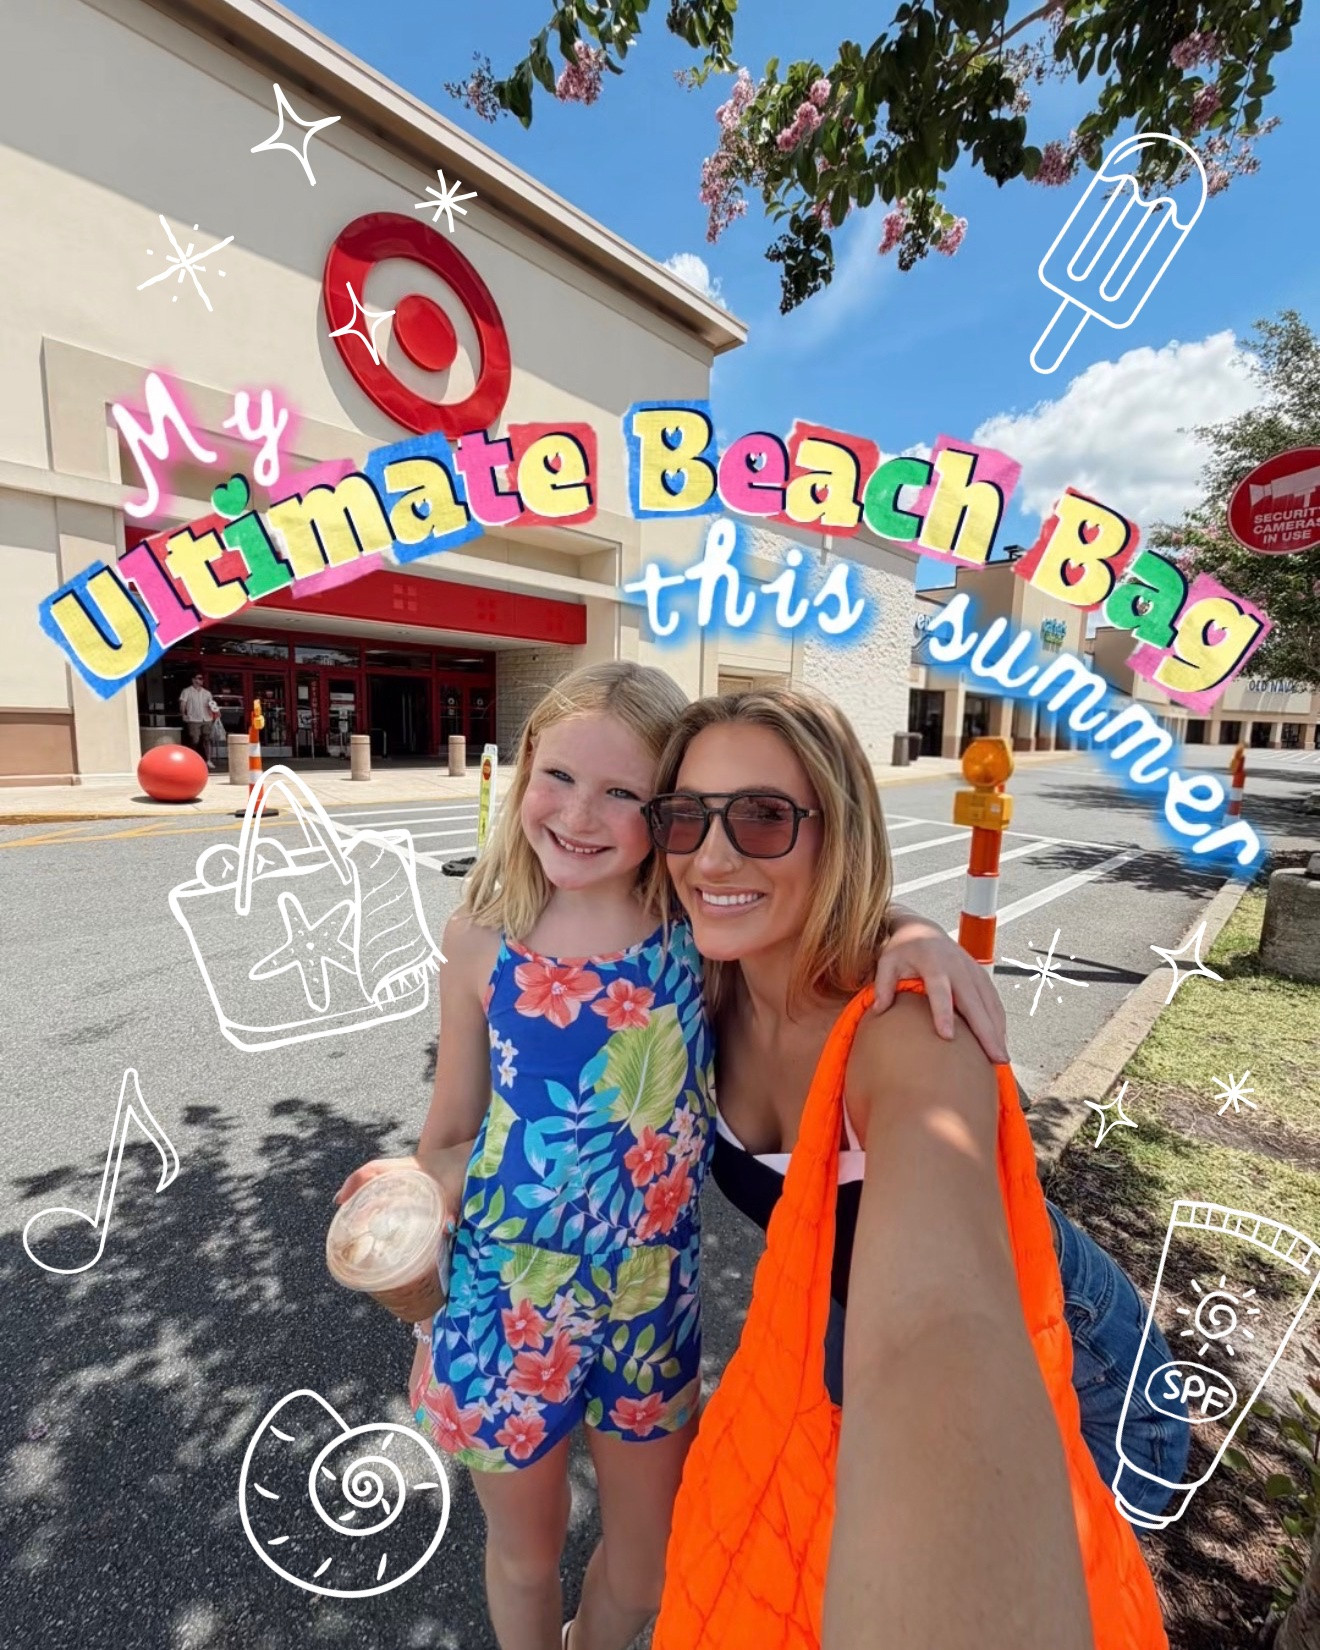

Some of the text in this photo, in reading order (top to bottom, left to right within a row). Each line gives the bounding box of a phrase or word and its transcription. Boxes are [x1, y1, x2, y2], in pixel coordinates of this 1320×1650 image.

[1254, 506, 1320, 524] SECURIT
[1263, 529, 1312, 544] IN USE
[1248, 680, 1267, 692] OLD
